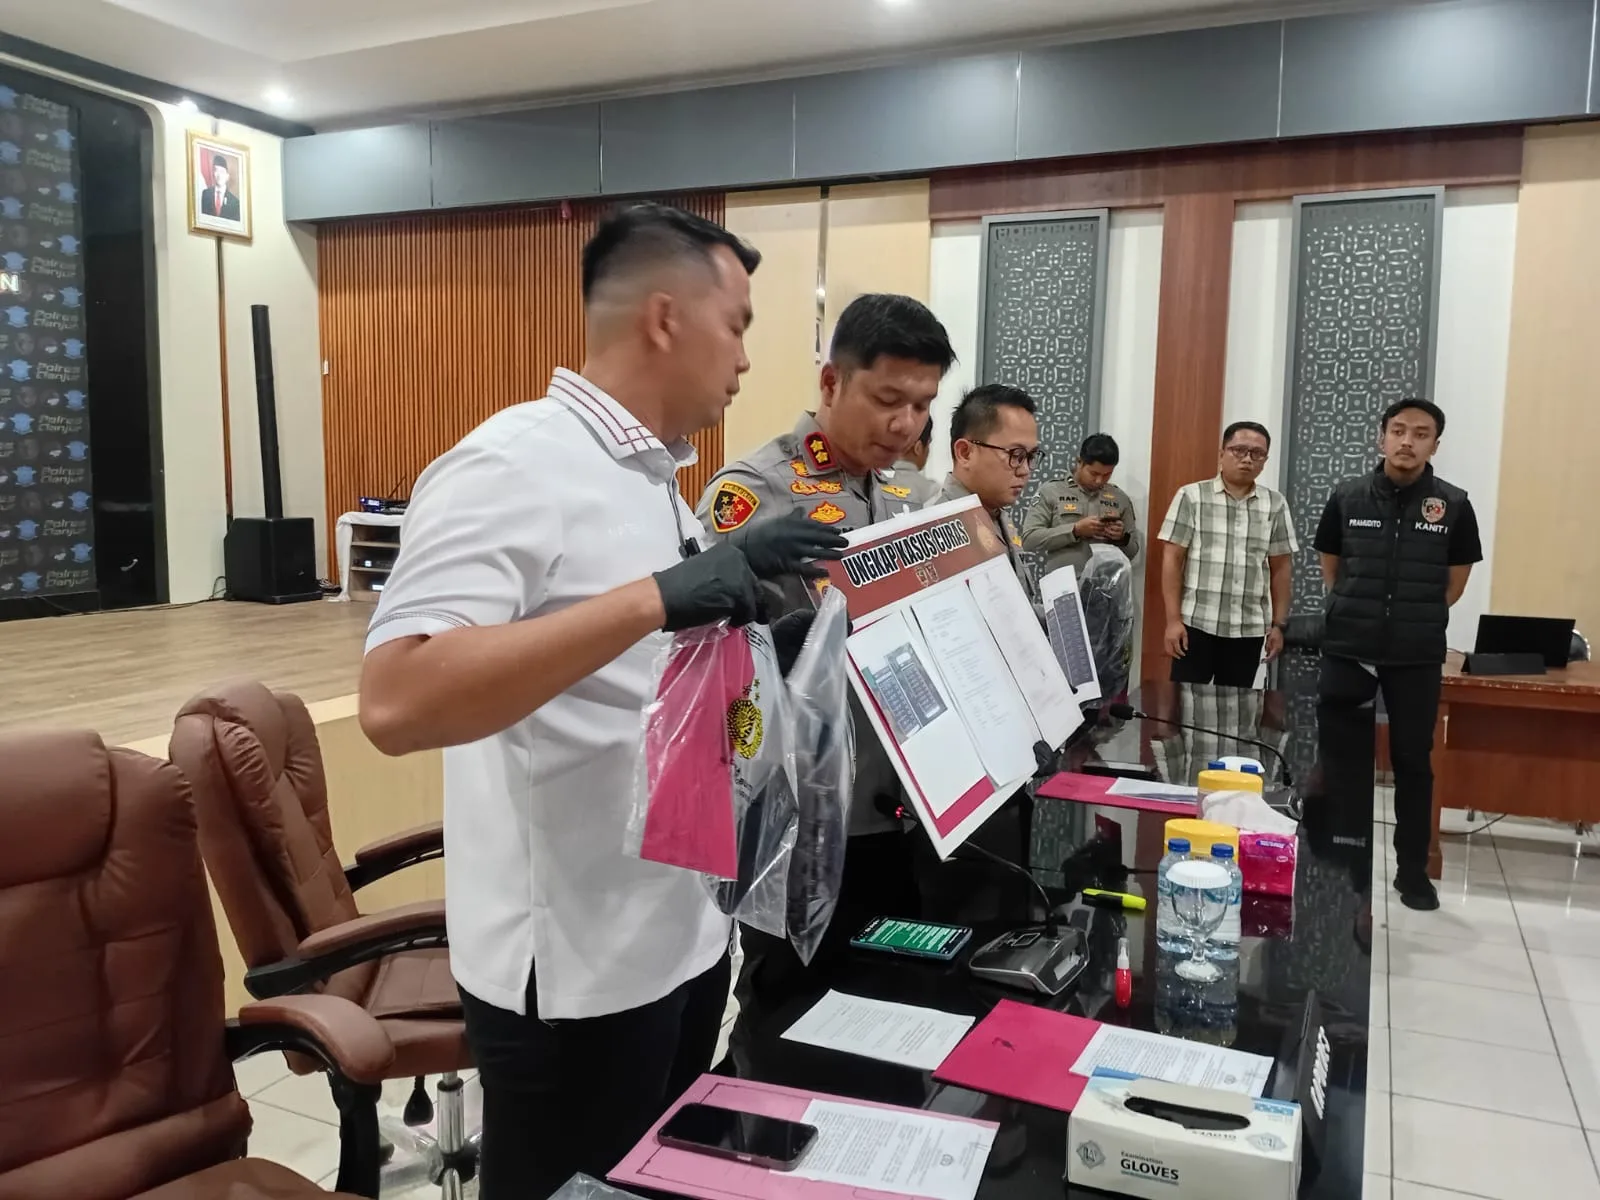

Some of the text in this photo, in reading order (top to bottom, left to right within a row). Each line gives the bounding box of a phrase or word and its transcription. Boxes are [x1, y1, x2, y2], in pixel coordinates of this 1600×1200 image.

[1415, 522, 1444, 533] KANIT
[842, 519, 970, 587] UNGKAP KASUS CURAS
[1121, 1158, 1179, 1181] GLOVES
